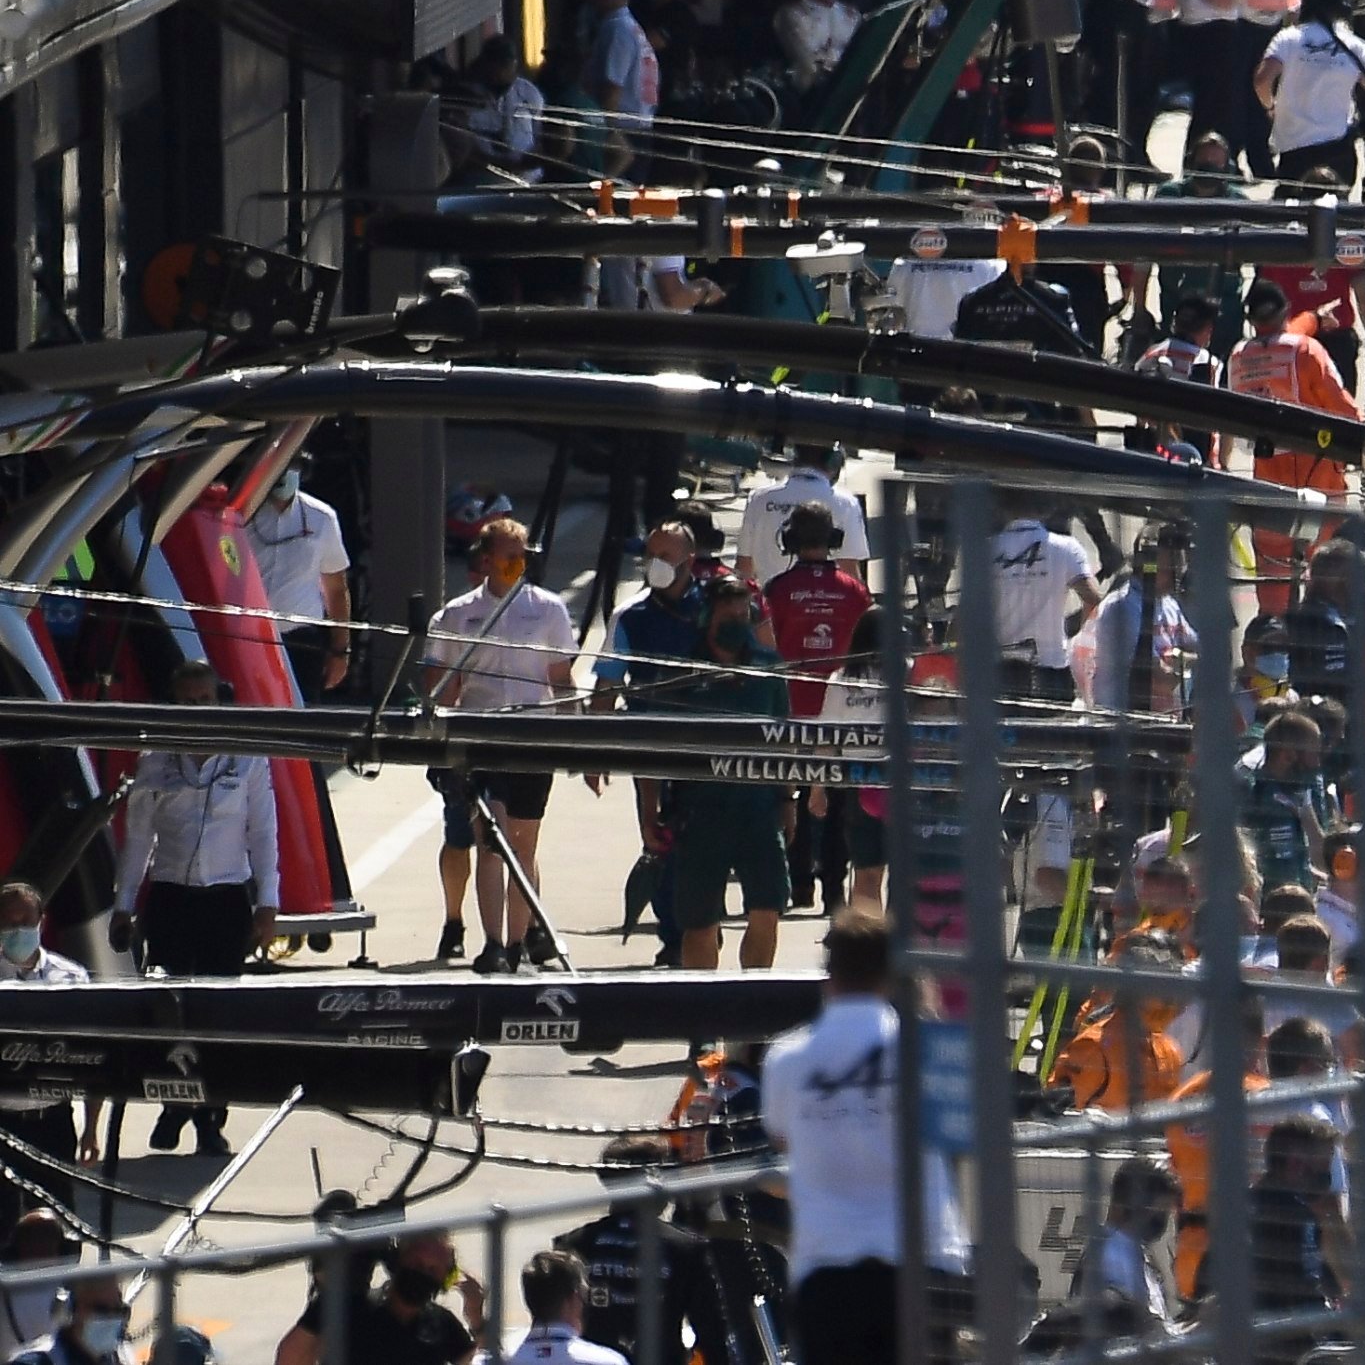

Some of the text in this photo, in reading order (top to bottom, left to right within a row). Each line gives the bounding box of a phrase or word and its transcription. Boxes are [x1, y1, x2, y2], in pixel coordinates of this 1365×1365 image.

[305, 291, 324, 333] brembo
[761, 724, 885, 746] WILLIAM
[711, 758, 843, 782] WILLIAMS
[504, 1022, 577, 1042] ORLEN
